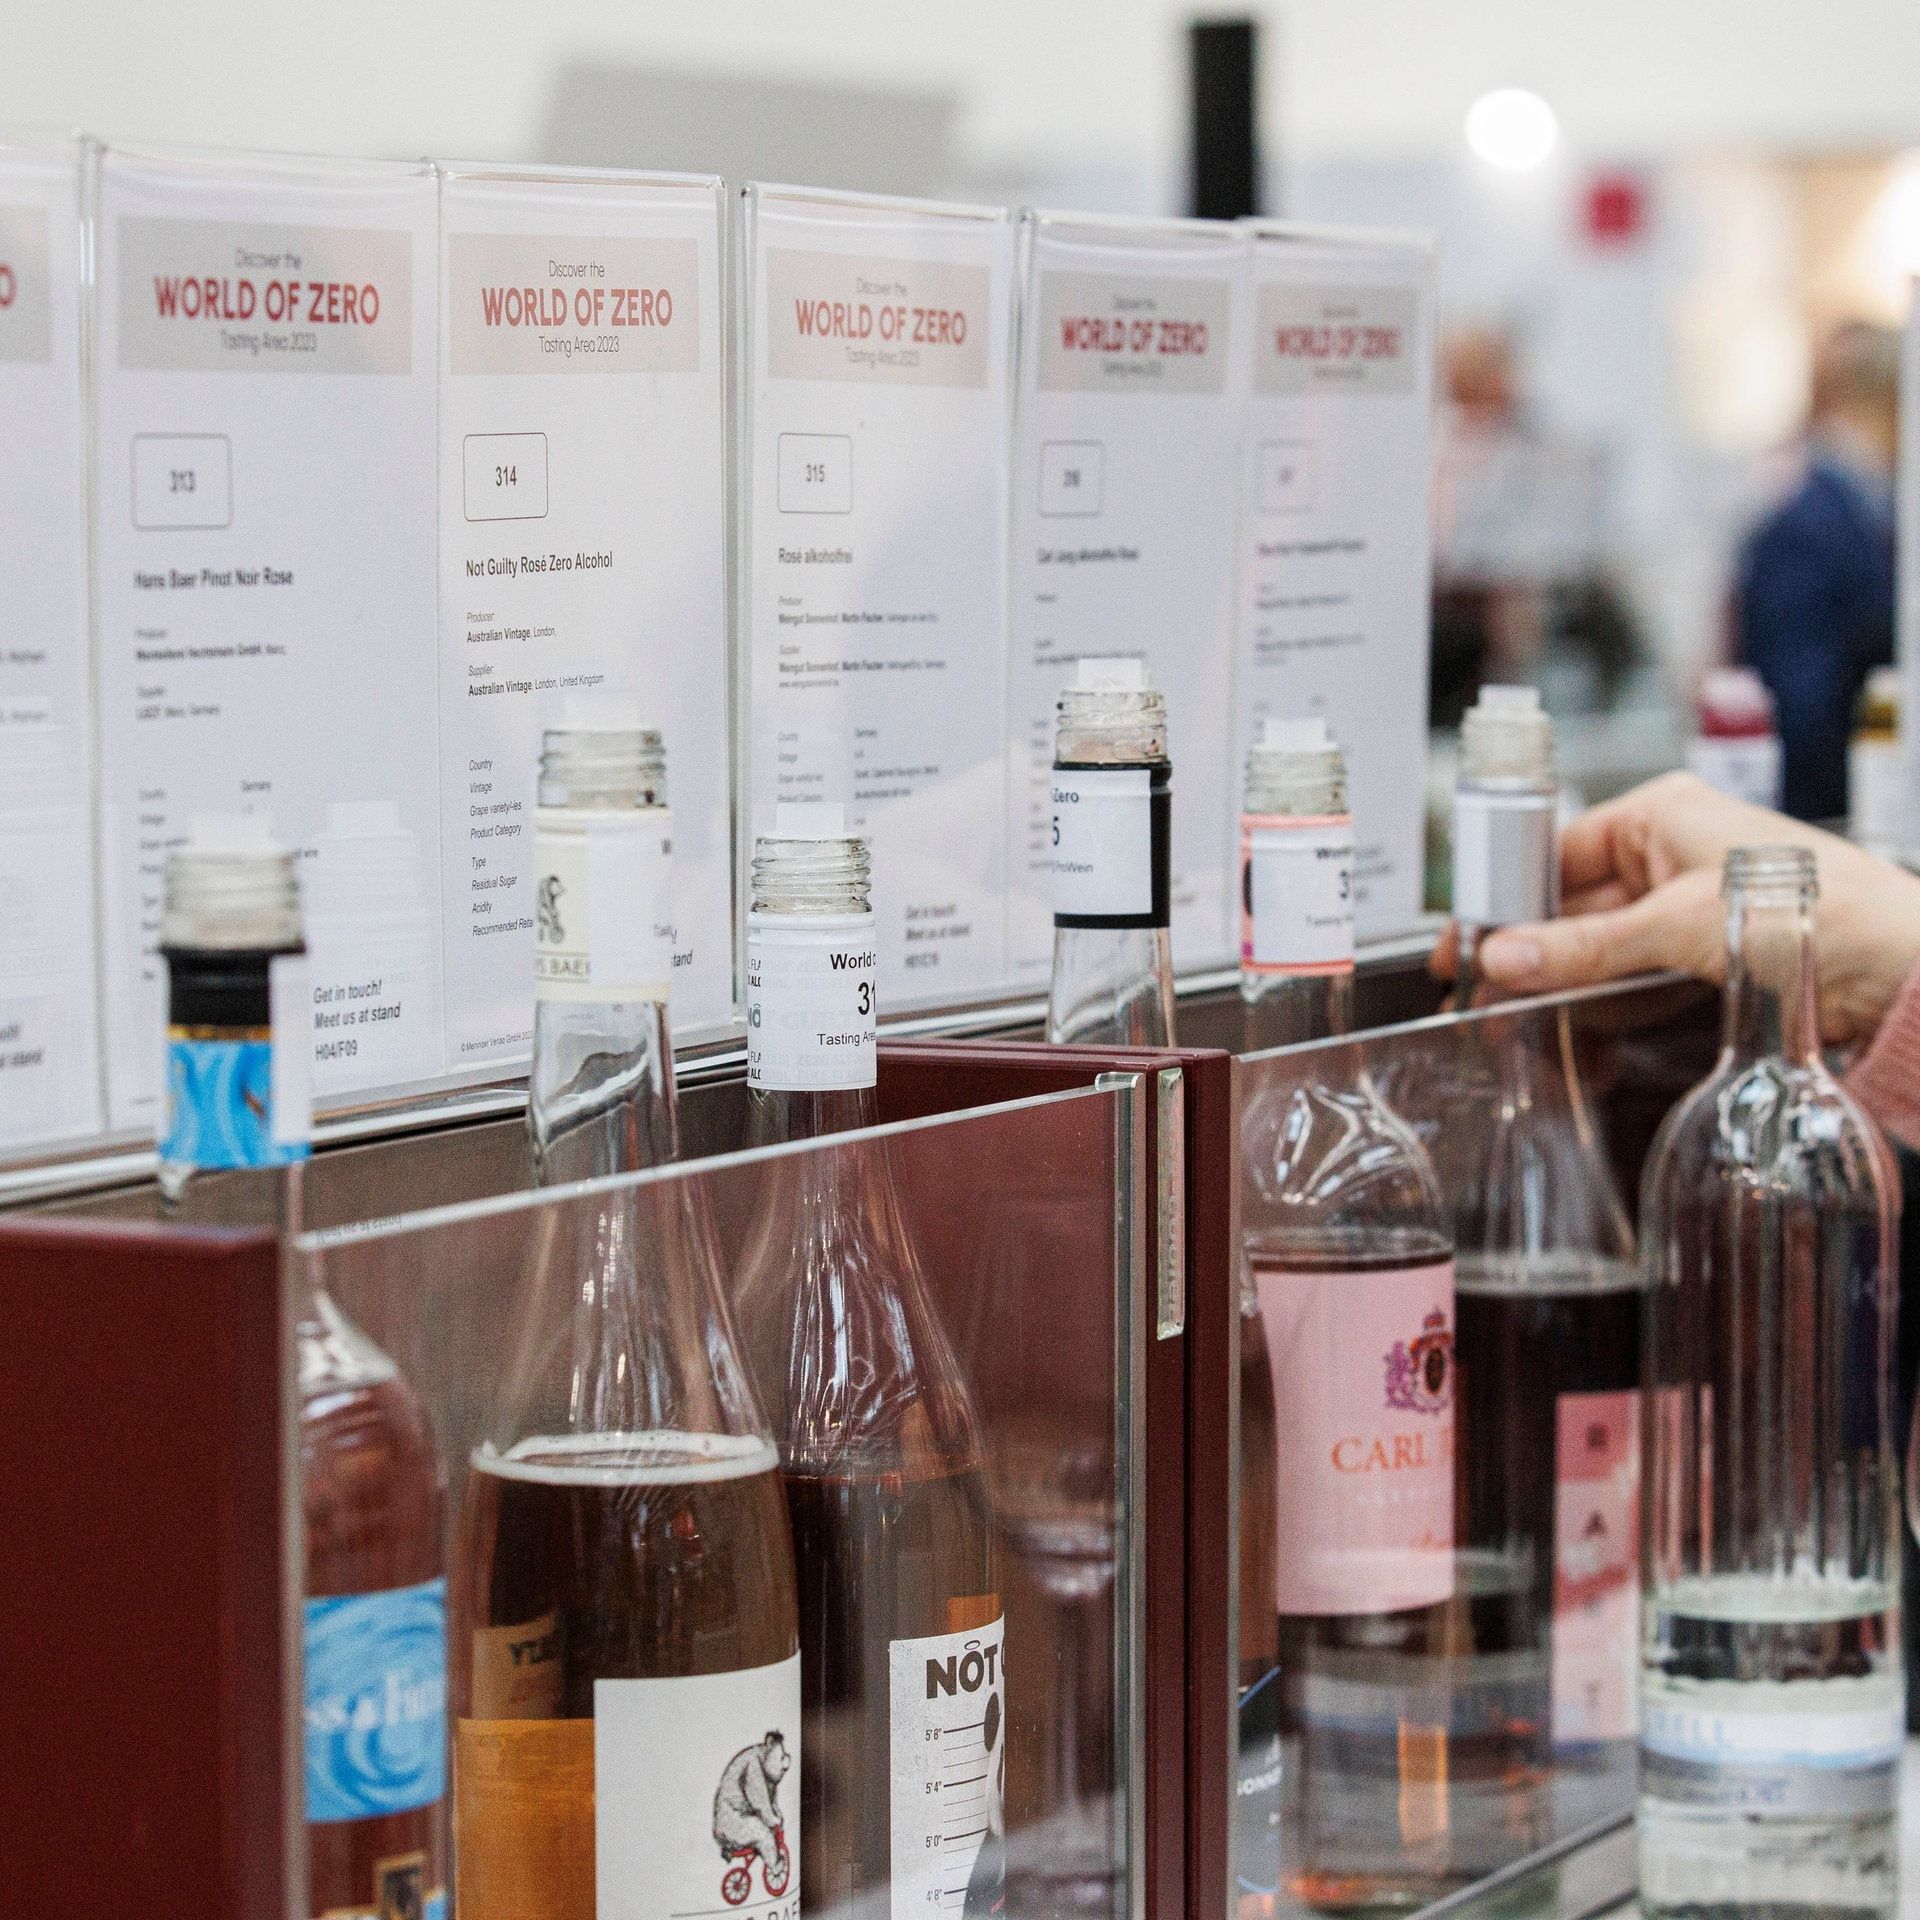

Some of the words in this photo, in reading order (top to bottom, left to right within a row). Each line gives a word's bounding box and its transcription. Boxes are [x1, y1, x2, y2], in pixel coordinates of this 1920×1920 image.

[549, 261, 586, 277] Discover
[589, 261, 605, 277] the
[154, 277, 257, 319] WORLD
[264, 280, 300, 321] OF
[308, 283, 380, 324] ZERO
[481, 287, 568, 327] WORLD
[574, 288, 604, 326] OF
[611, 289, 673, 327] ZERO
[795, 299, 873, 339] WORLD
[879, 305, 907, 341] OF
[913, 308, 967, 345] ZERO
[538, 336, 571, 357] Tasting
[574, 337, 596, 352] Area
[597, 337, 620, 353] 2023
[495, 466, 517, 486] 314
[805, 463, 825, 483] 315
[466, 560, 484, 577] Not
[487, 558, 518, 578] Guilty
[520, 555, 547, 573] Rosé
[549, 554, 572, 572] Zero
[574, 551, 613, 570] Alcohol
[467, 630, 503, 643] Australian
[468, 683, 505, 697] Australian
[469, 759, 493, 772] Country
[469, 782, 493, 795] Vintage
[469, 805, 488, 819] Grape
[470, 827, 494, 839] Product
[495, 823, 522, 837] Category
[472, 857, 486, 870] Type
[471, 878, 498, 891] Residual
[499, 875, 518, 888] Sugar
[472, 901, 493, 914] Acidity
[472, 920, 518, 937] Recommended
[830, 951, 872, 970] World
[313, 986, 332, 1003] Get
[314, 1010, 340, 1029] Meet
[342, 1011, 356, 1025] us
[358, 1007, 369, 1023] at
[371, 1000, 401, 1021] stand
[817, 1031, 860, 1046] Tasting
[926, 1640, 998, 1699] NOT
